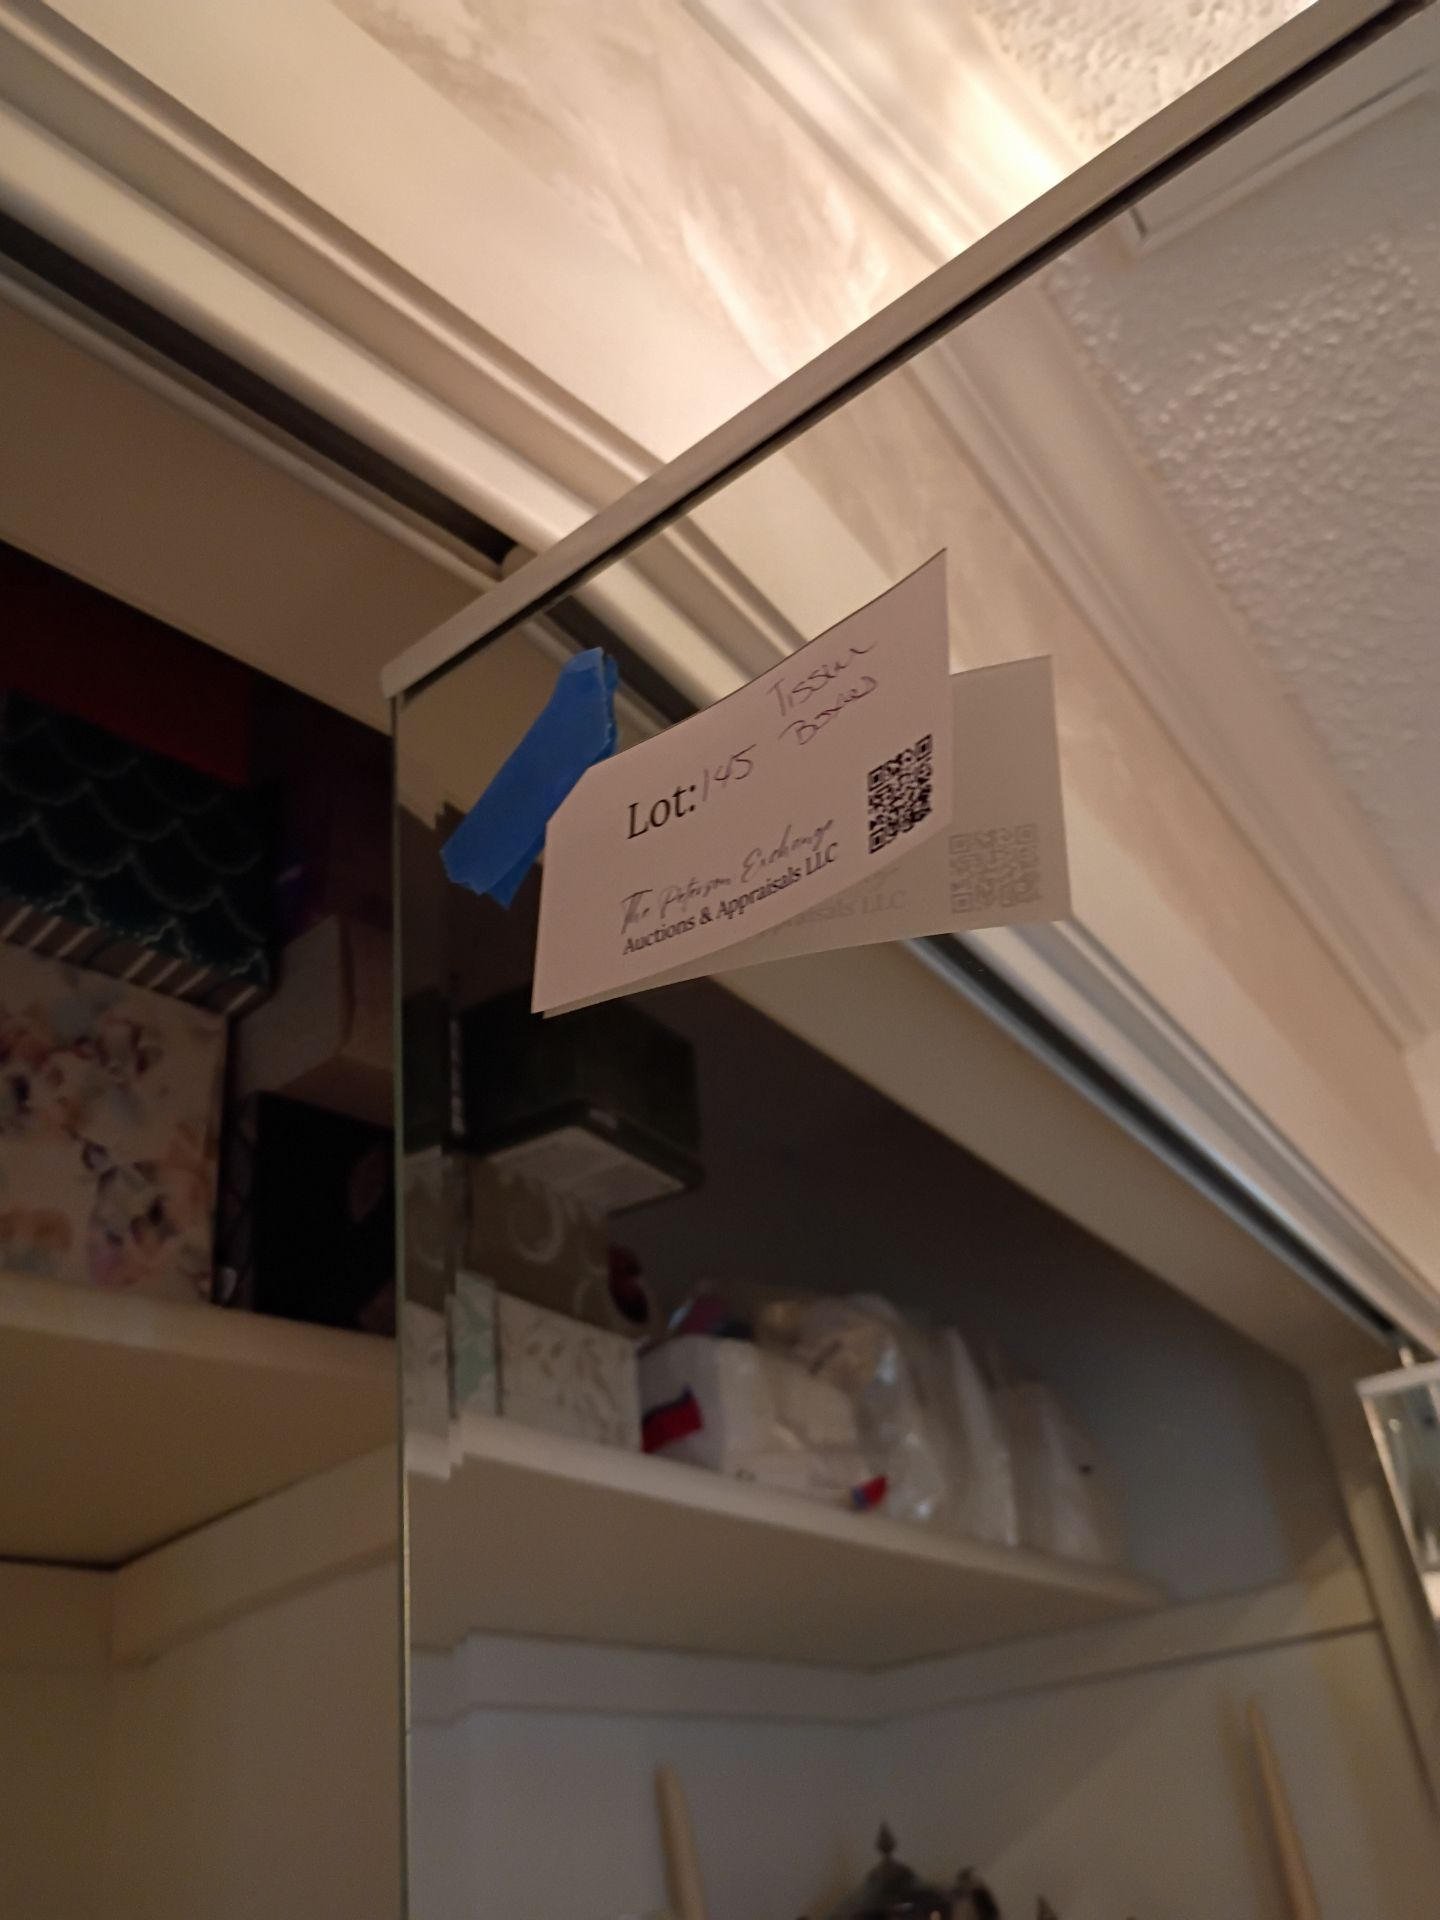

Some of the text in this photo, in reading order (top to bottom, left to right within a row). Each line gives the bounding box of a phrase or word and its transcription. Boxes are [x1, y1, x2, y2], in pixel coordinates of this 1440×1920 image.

[627, 743, 757, 840] Lot: 145
[620, 889, 653, 935] The
[740, 818, 834, 884] Exchange
[622, 915, 696, 955] Auctions
[698, 906, 714, 926] &
[715, 866, 801, 920] Appraisals
[805, 842, 839, 876] LLC
